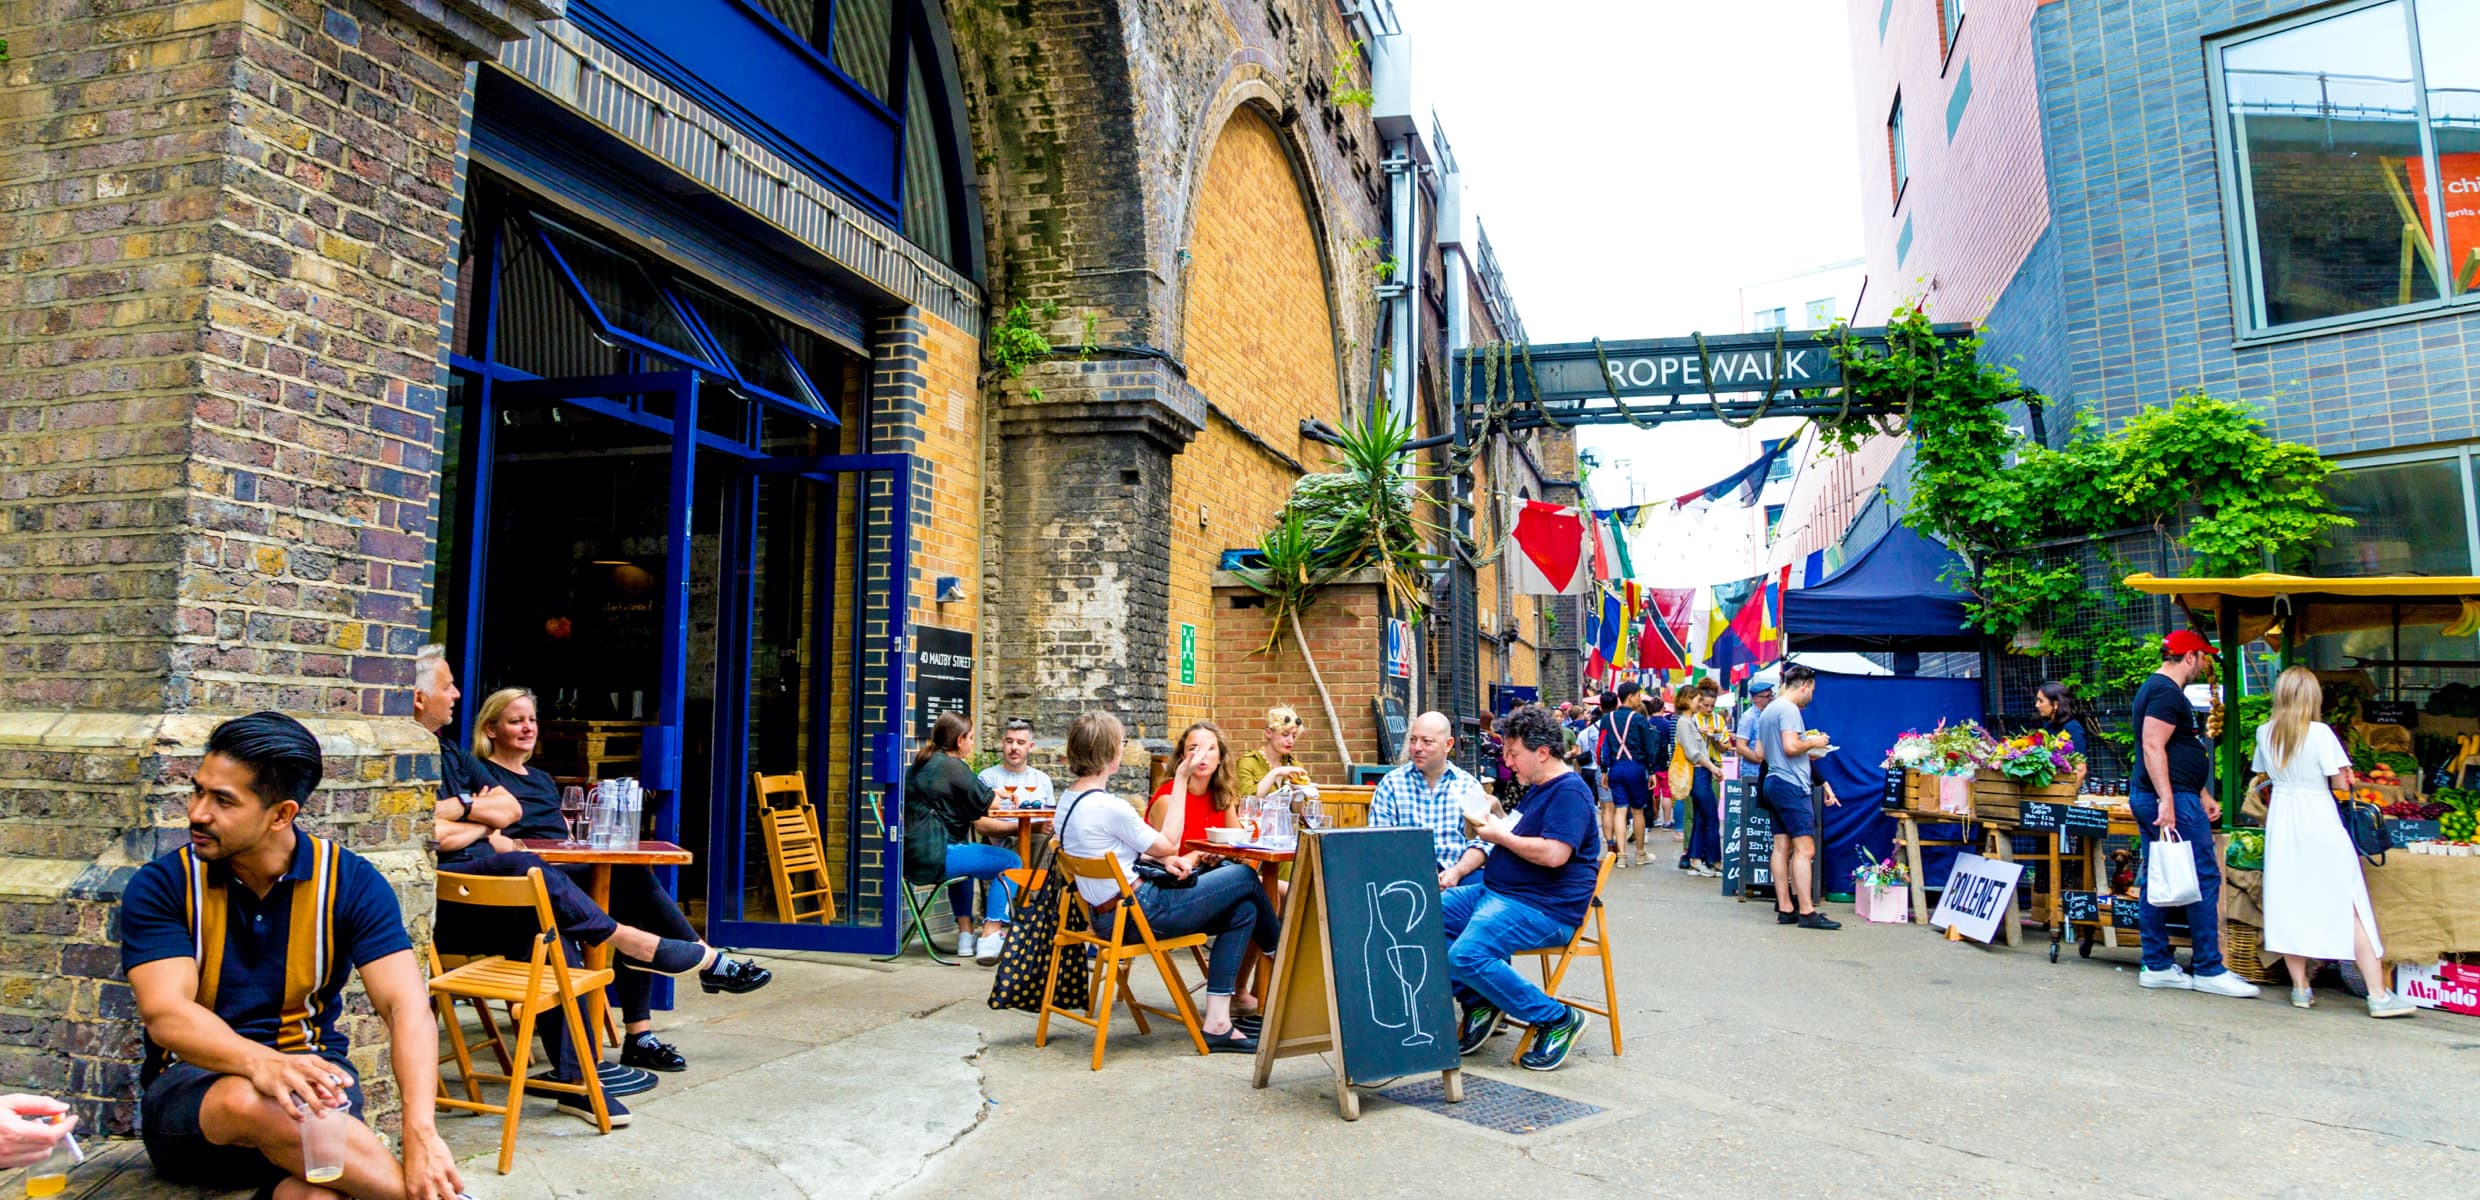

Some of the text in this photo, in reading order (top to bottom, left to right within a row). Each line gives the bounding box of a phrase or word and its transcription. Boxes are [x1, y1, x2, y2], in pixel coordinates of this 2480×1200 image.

[1608, 350, 1811, 388] ROPEWALK
[929, 651, 952, 667] MALTBY
[952, 655, 972, 669] STREET
[1746, 828, 1773, 837] Berm
[1749, 854, 1769, 863] Tak
[1944, 871, 2007, 920] POLLENET
